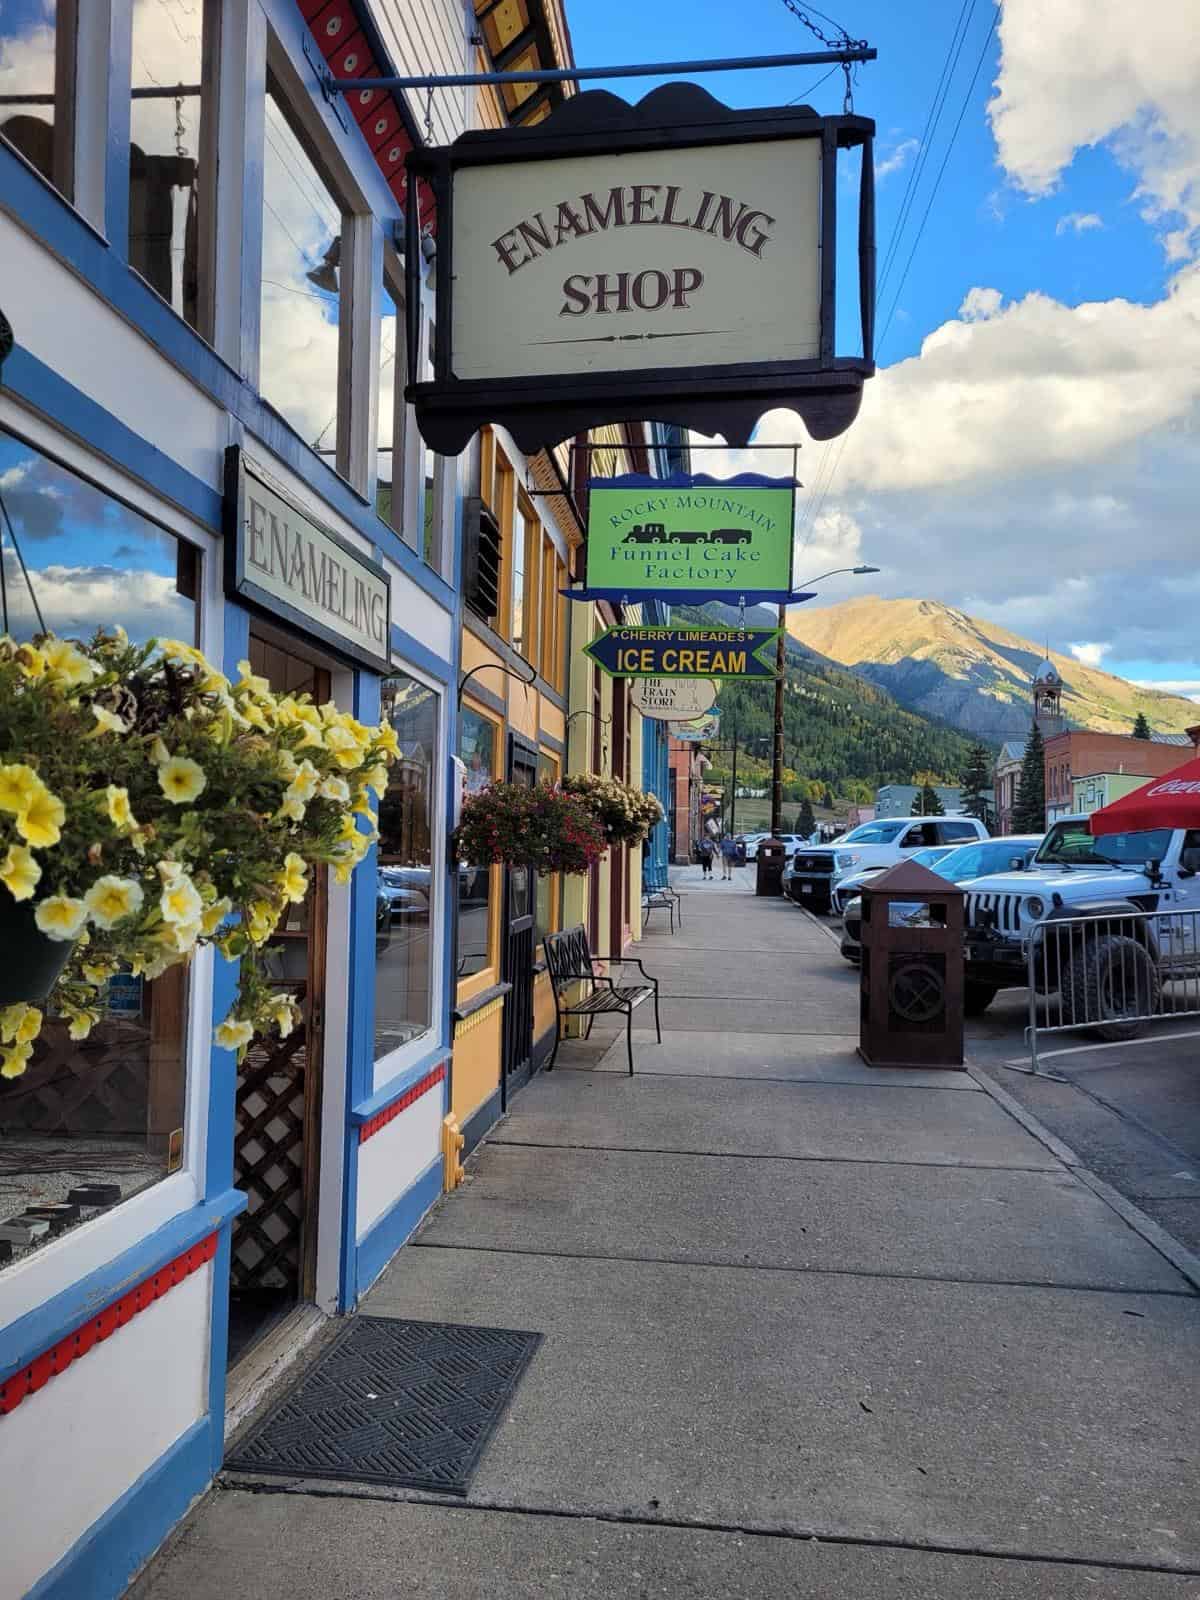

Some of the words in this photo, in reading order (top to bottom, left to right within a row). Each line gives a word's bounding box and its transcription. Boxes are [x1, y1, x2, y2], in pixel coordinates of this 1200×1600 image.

[491, 185, 776, 275] ENAMELING
[559, 268, 705, 317] SHOP
[608, 498, 668, 529] ROCKY
[675, 496, 776, 532] MOUNTAIN
[610, 546, 690, 561] Funnel
[703, 547, 760, 561] Cake
[248, 496, 384, 643] ENAMELING
[644, 564, 737, 582] Factory
[620, 630, 674, 641] CHERRY
[677, 631, 745, 642] LIMEADES
[617, 649, 654, 671] ICE
[662, 650, 746, 673] CREAM
[640, 687, 677, 697] TRAIN
